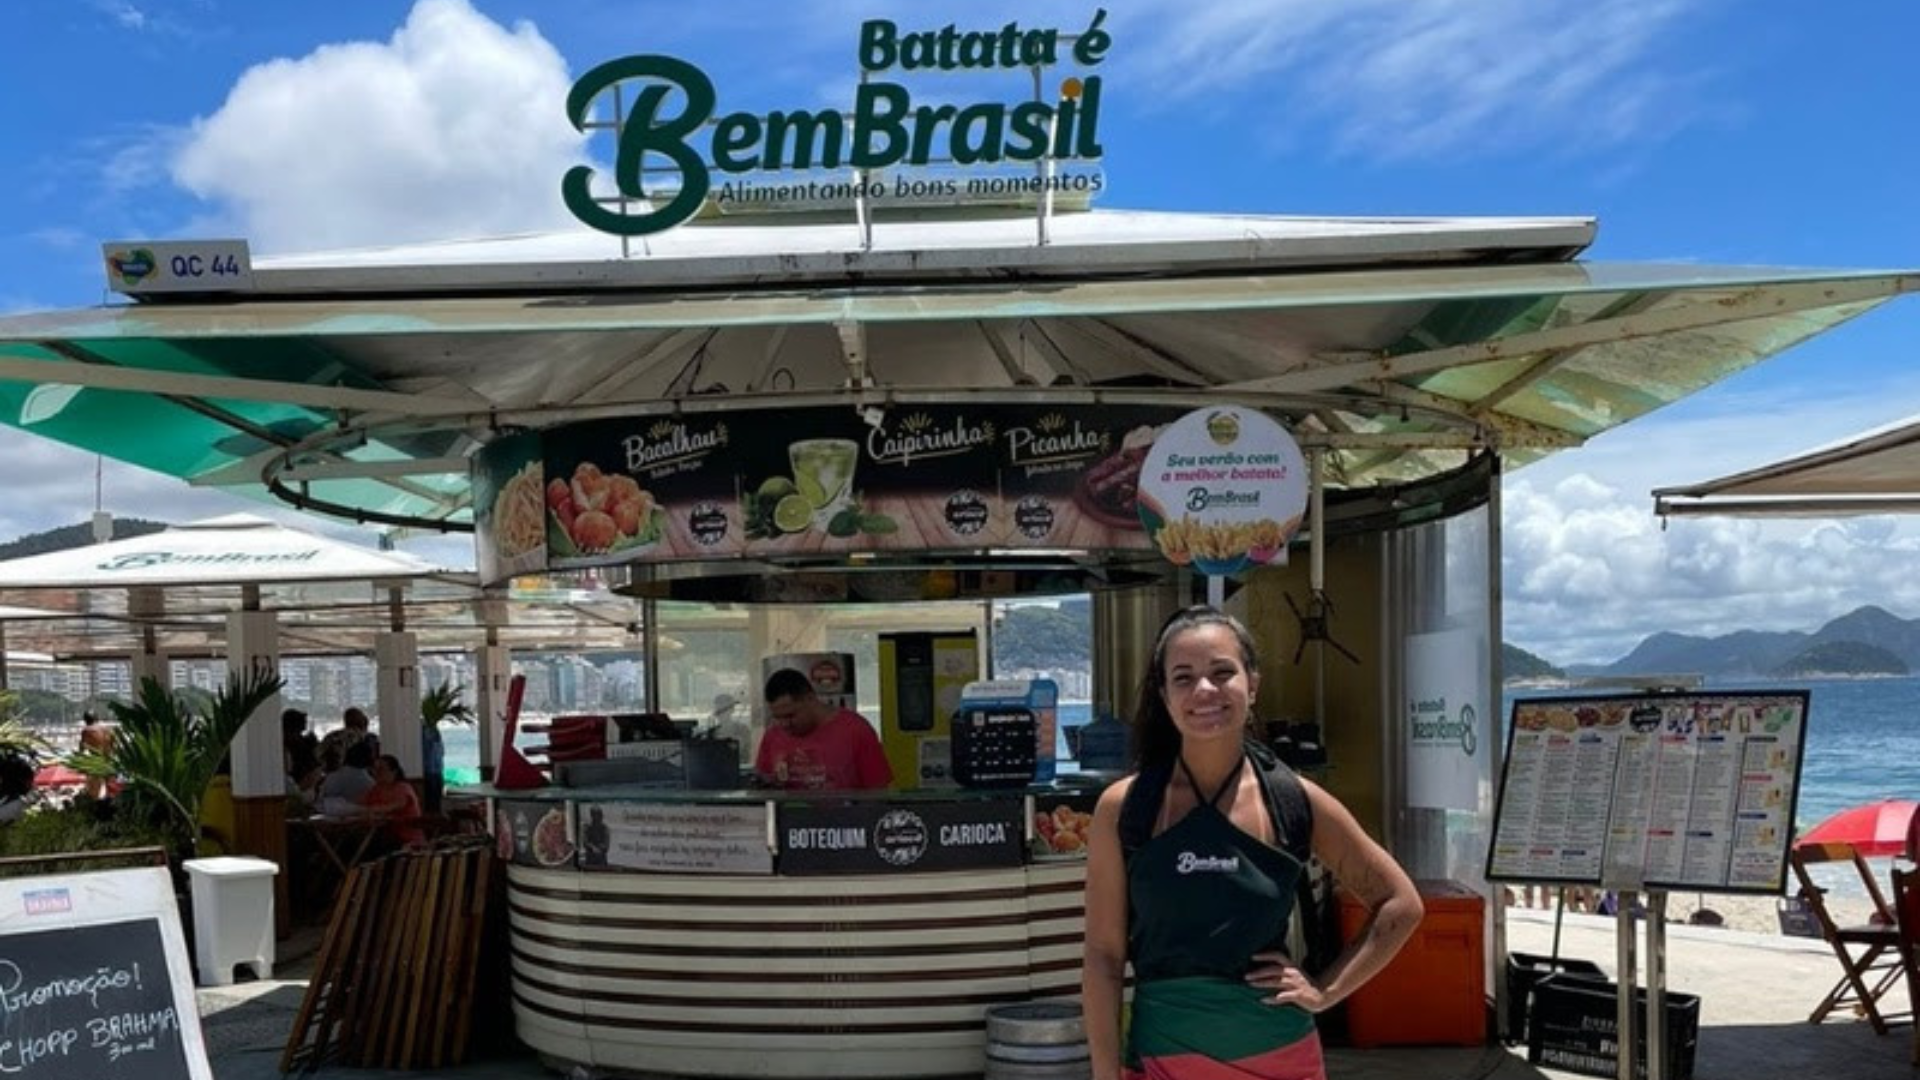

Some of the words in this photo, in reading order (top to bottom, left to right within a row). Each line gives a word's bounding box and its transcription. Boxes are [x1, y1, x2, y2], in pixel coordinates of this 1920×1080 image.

[859, 19, 1058, 72] Batata
[1074, 8, 1112, 65] é
[561, 54, 1103, 237] BemBrasil
[718, 176, 886, 204] Alimentando
[894, 168, 957, 198] bons
[967, 171, 1103, 196] momentos
[171, 254, 204, 278] QC
[211, 254, 240, 277] 44
[621, 423, 718, 471] Bacalhau
[867, 415, 984, 467] Caipirinha
[1003, 419, 1100, 466] Picanha
[1166, 453, 1196, 468] Seu
[1198, 452, 1244, 465] verão
[1247, 453, 1280, 465] com
[1161, 472, 1172, 483] a
[1174, 467, 1228, 483] melhor
[1230, 465, 1288, 481] batata!
[788, 827, 867, 850] BOTEQUIM
[85, 1006, 181, 1049] BRAHMA
